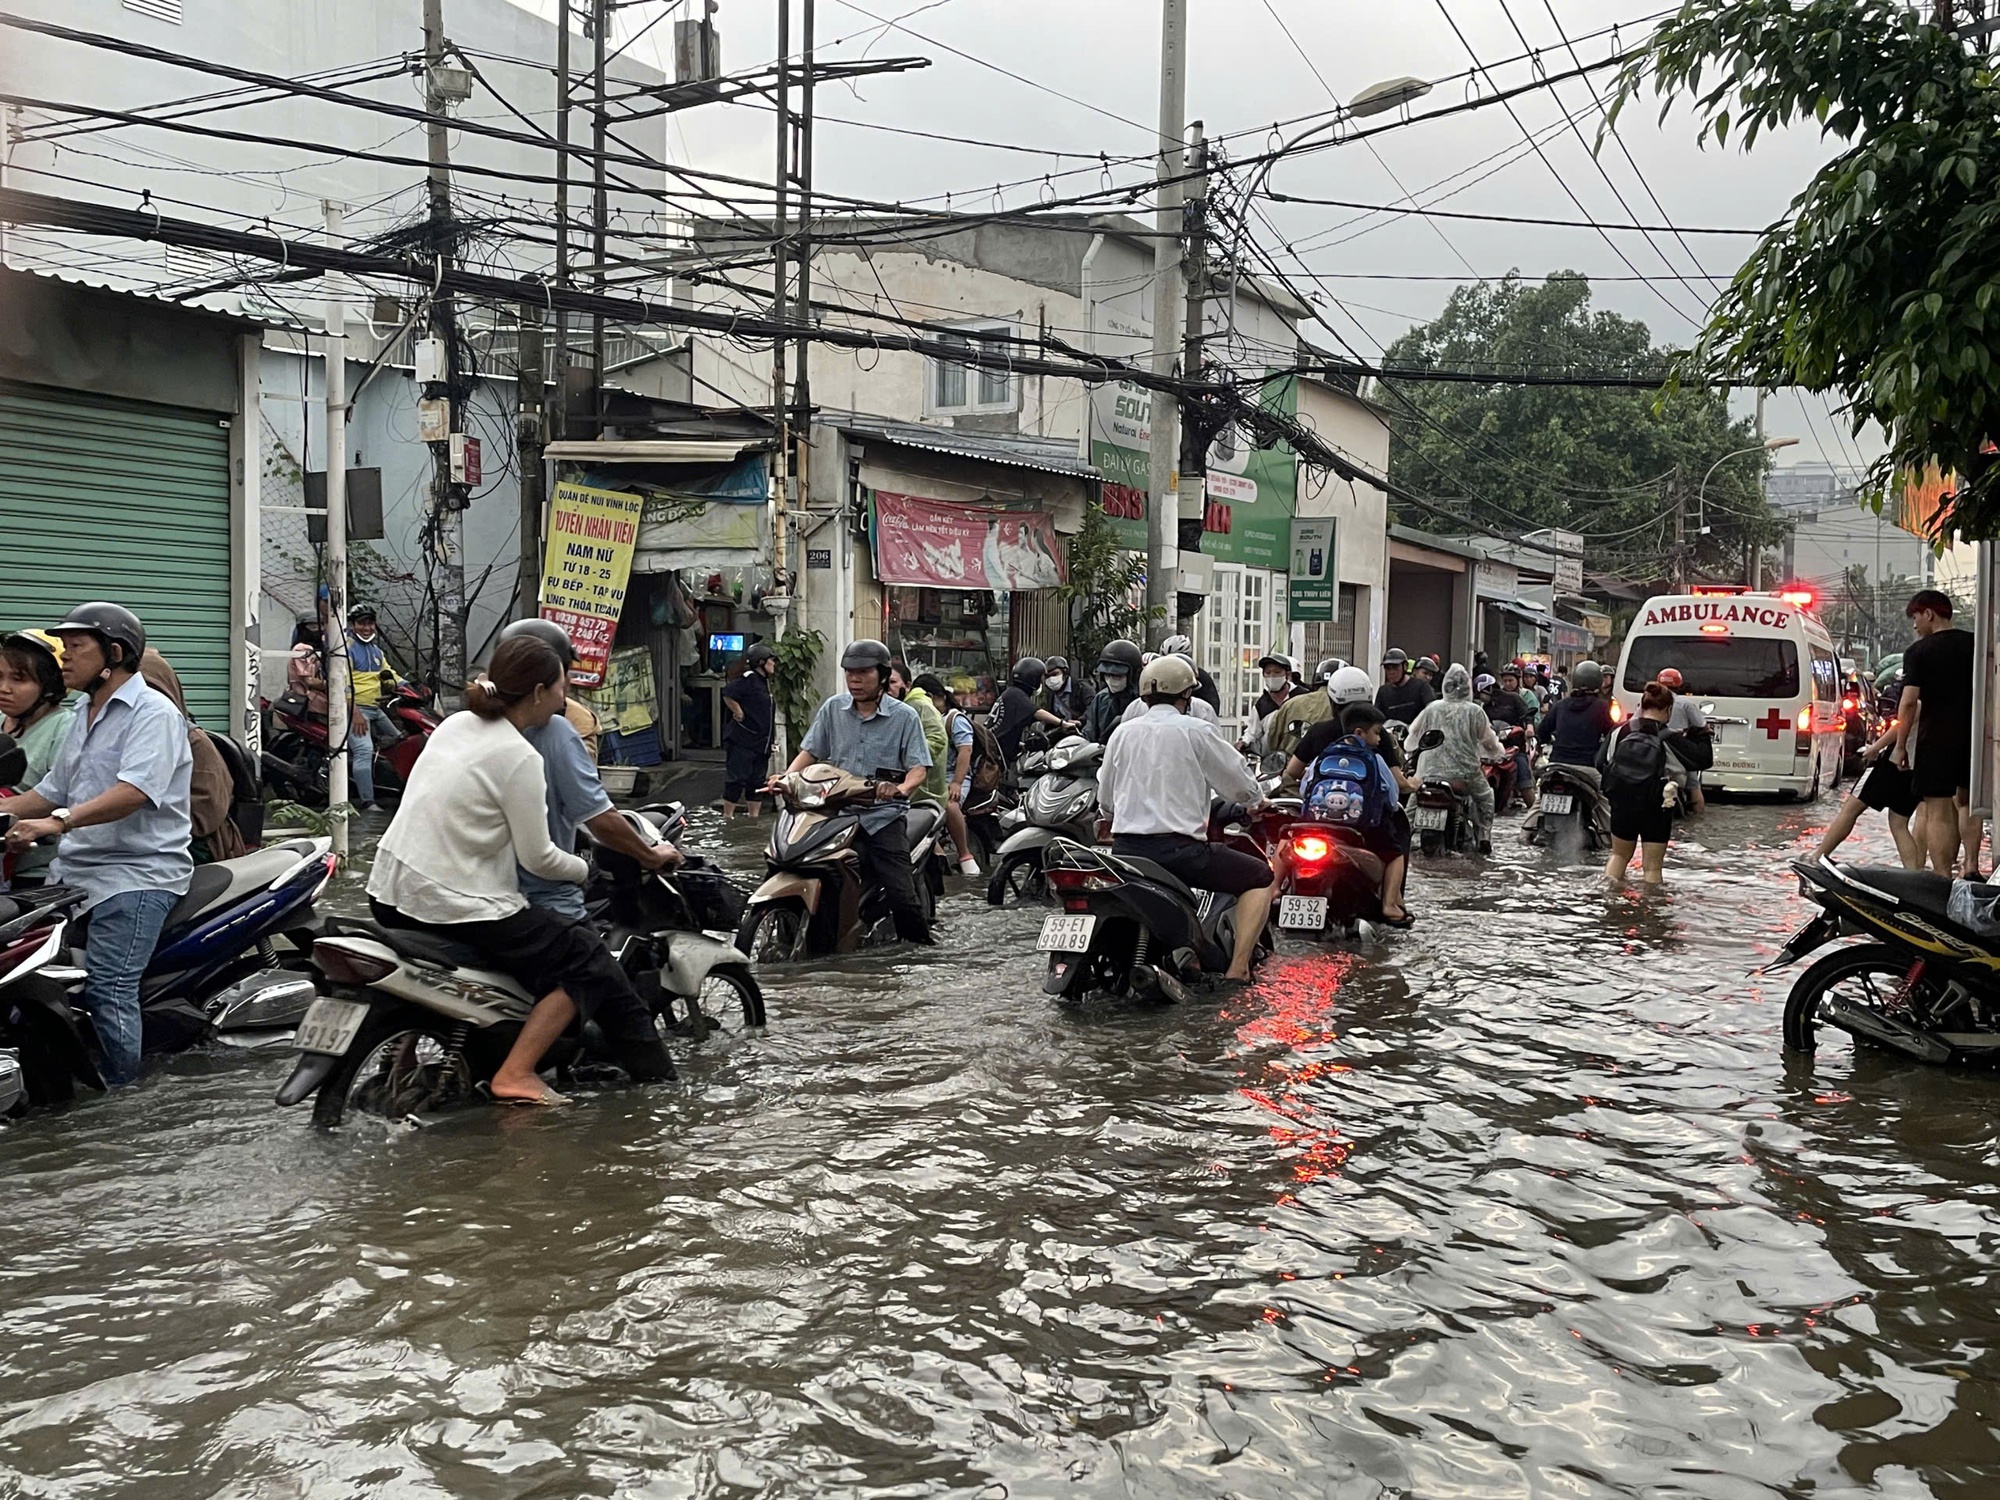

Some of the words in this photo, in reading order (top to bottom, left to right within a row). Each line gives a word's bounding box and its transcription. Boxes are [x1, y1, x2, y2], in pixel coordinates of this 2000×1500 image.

[1115, 395, 1151, 424] SOUT
[1112, 421, 1137, 438] Natural
[1139, 428, 1151, 441] Ene
[1103, 452, 1119, 473] ĐẠI
[613, 518, 636, 545] VIÊN
[566, 542, 593, 560] NAM
[596, 547, 614, 563] NỮ
[809, 551, 829, 560] 206
[579, 564, 590, 576] 18
[599, 568, 612, 580] 25
[1644, 604, 1790, 629] AMBULANCE
[1288, 899, 1320, 913] 59-S2
[1050, 918, 1086, 933] 59-E1
[1282, 913, 1322, 927] 783.59
[1041, 934, 1087, 949] 990.89
